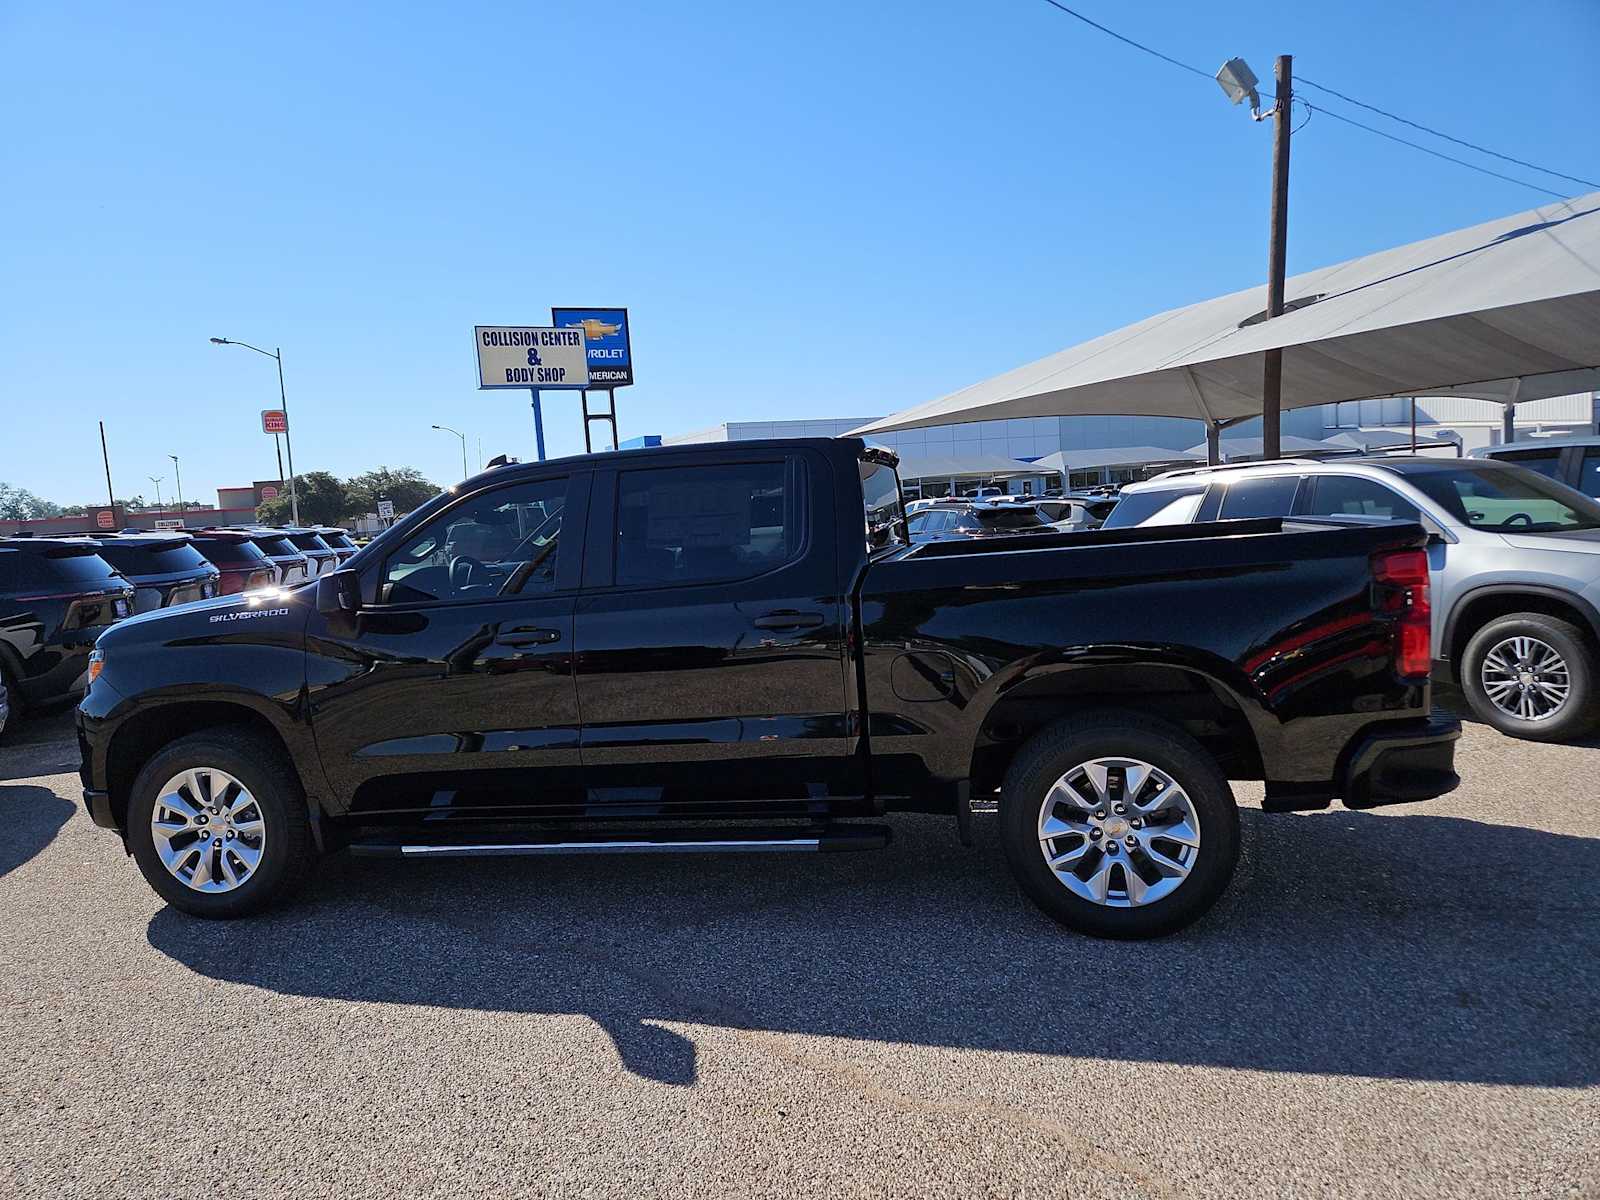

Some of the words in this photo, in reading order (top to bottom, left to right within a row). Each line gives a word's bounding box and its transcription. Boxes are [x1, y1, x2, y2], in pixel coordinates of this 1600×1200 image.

[482, 331, 539, 347] COLLISION
[541, 331, 581, 346] CENTER
[527, 347, 542, 366] &
[505, 368, 535, 382] BODY
[537, 367, 566, 382] SHOP
[208, 608, 290, 623] SILVERADO
